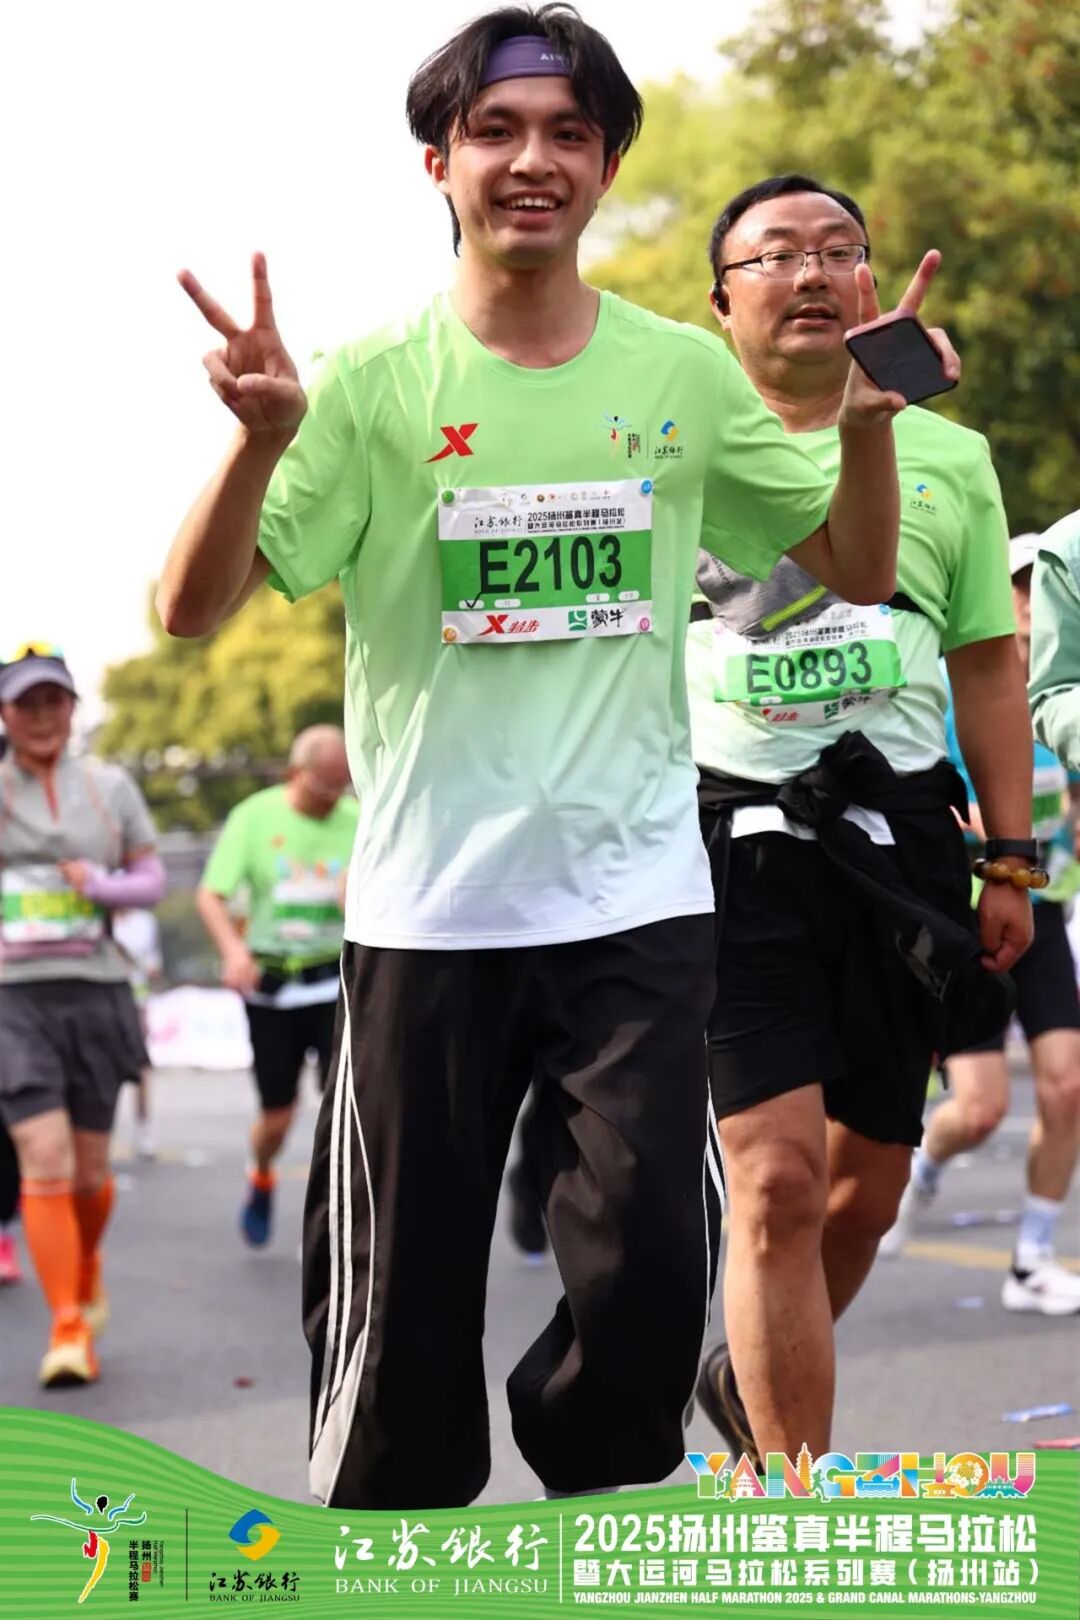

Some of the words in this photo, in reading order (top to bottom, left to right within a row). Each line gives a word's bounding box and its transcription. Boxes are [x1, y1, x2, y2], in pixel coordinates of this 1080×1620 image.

[479, 534, 622, 594] E2103
[590, 608, 624, 628] 蒙牛
[747, 641, 872, 694] E0893
